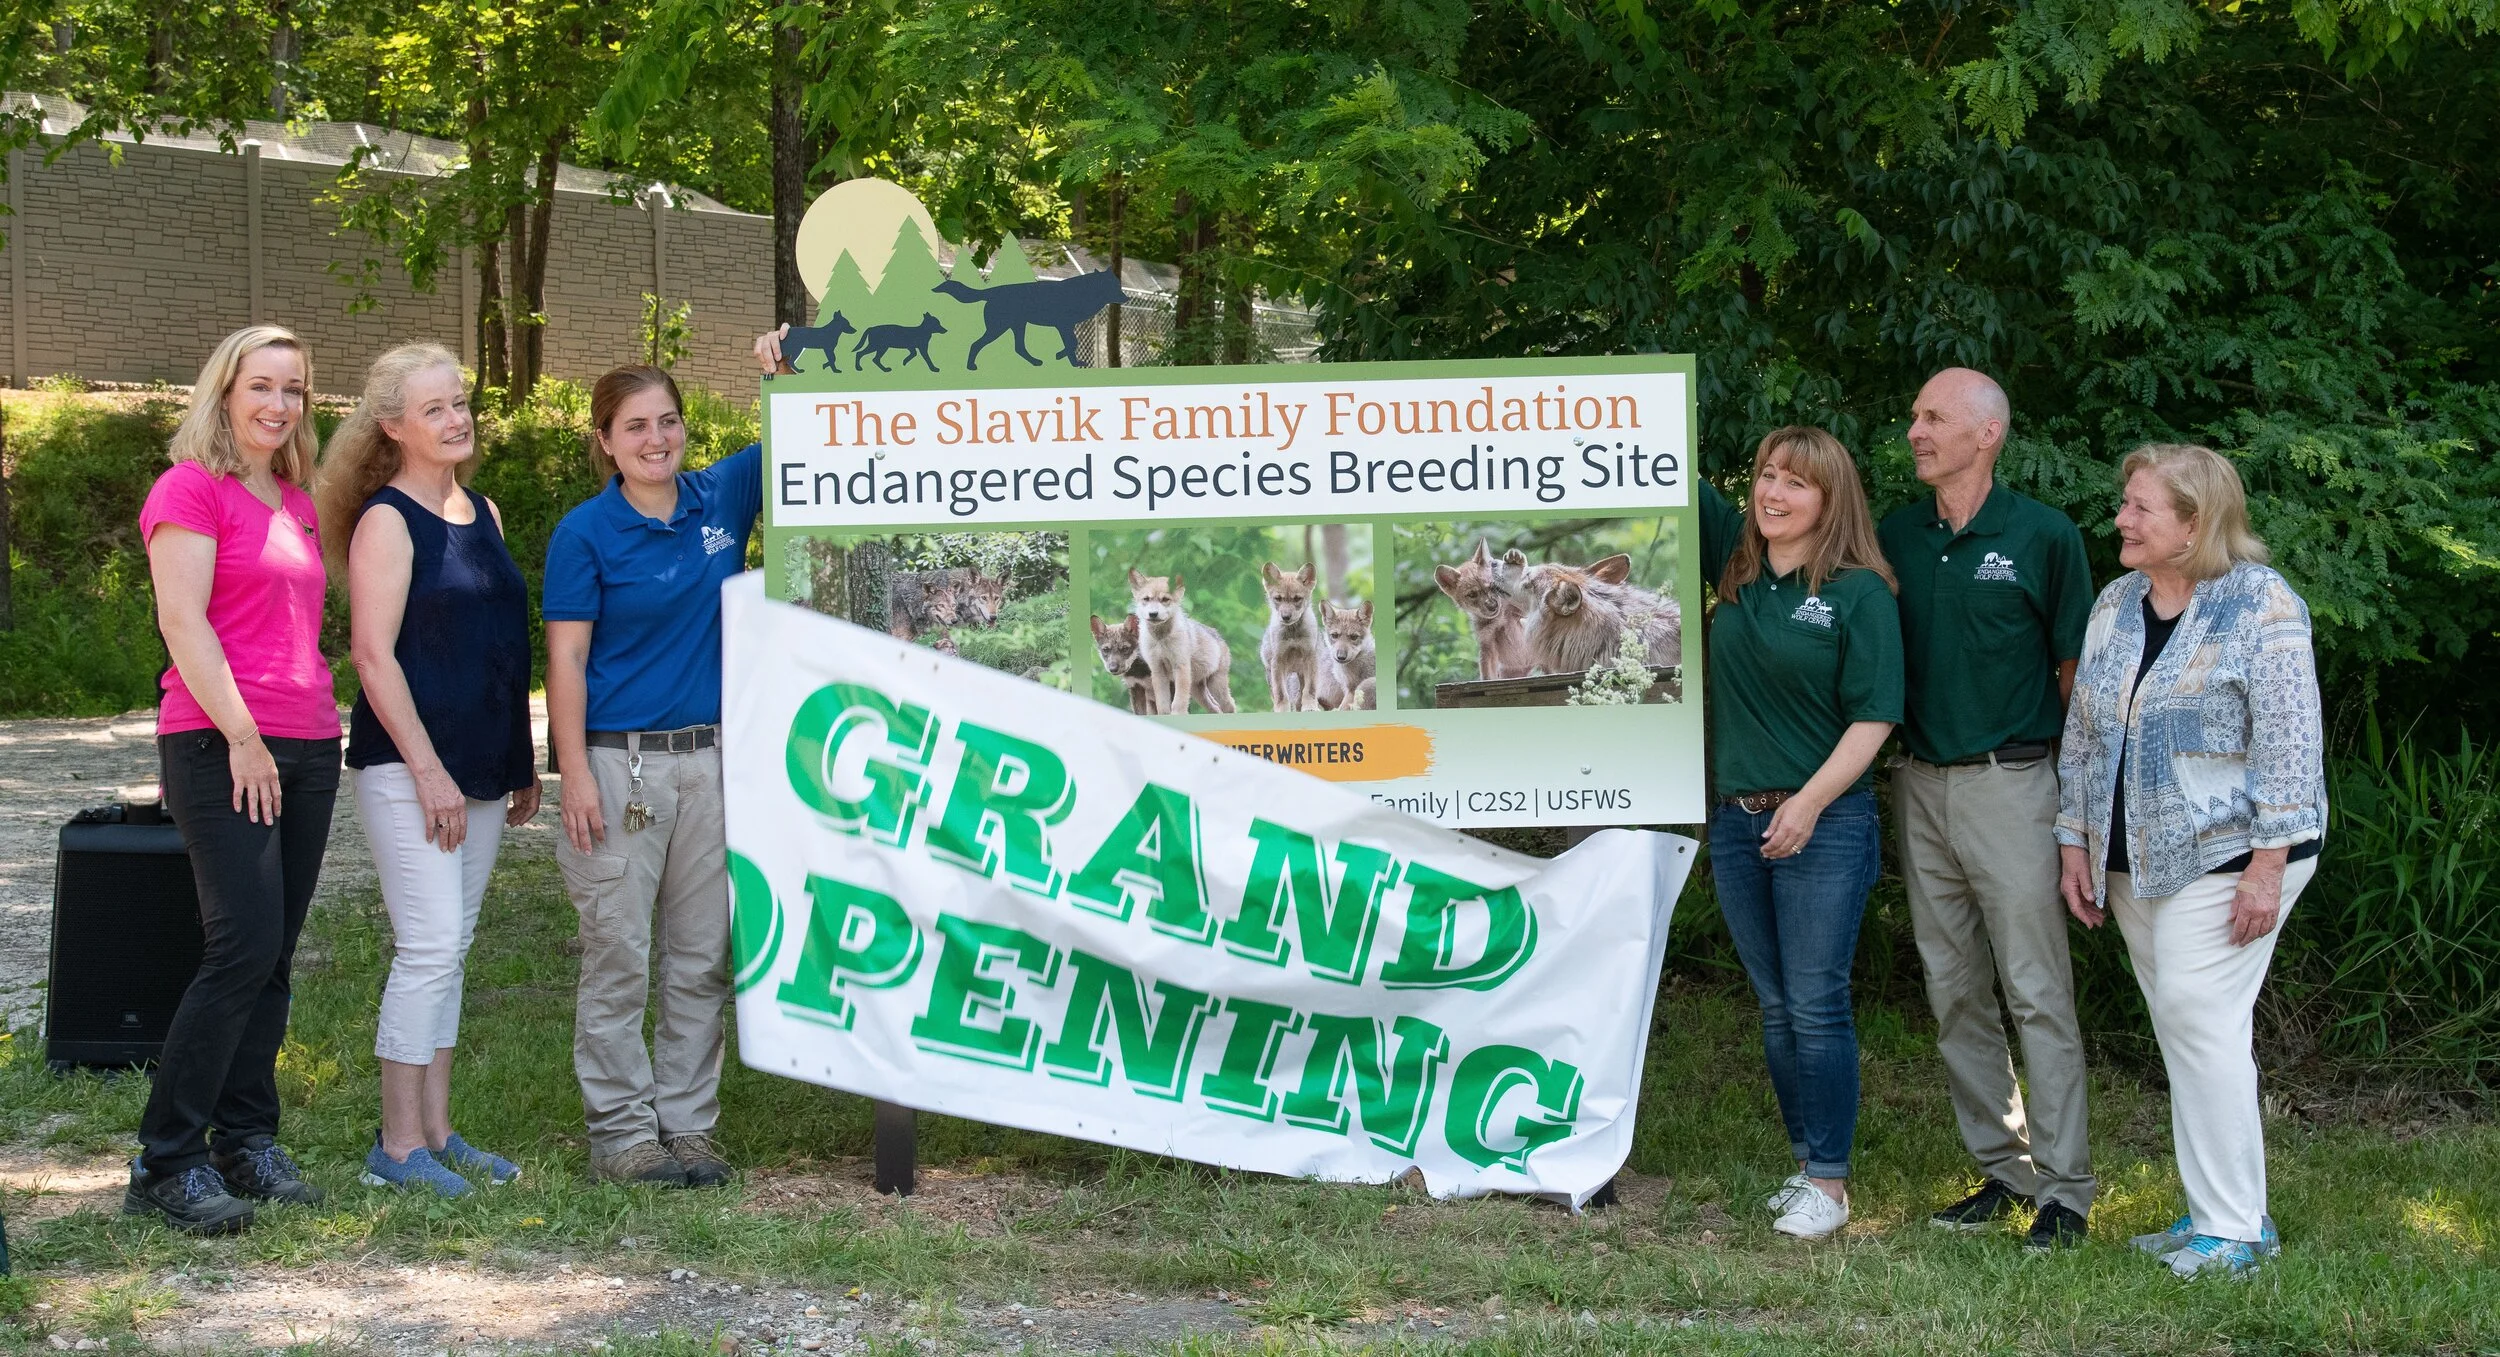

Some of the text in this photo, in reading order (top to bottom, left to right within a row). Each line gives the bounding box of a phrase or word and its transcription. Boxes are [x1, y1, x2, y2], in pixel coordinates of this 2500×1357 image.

[816, 384, 1642, 451] The Slavik Family Foundation
[780, 442, 1679, 517] Endangered Species Breeding Site
[1973, 573, 2017, 583] WOLF CENTER
[1791, 613, 1832, 629] WOLF CENTER
[1467, 790, 1528, 813] C2S2
[1547, 787, 1632, 812] USFWS
[785, 682, 1539, 992] GRAND
